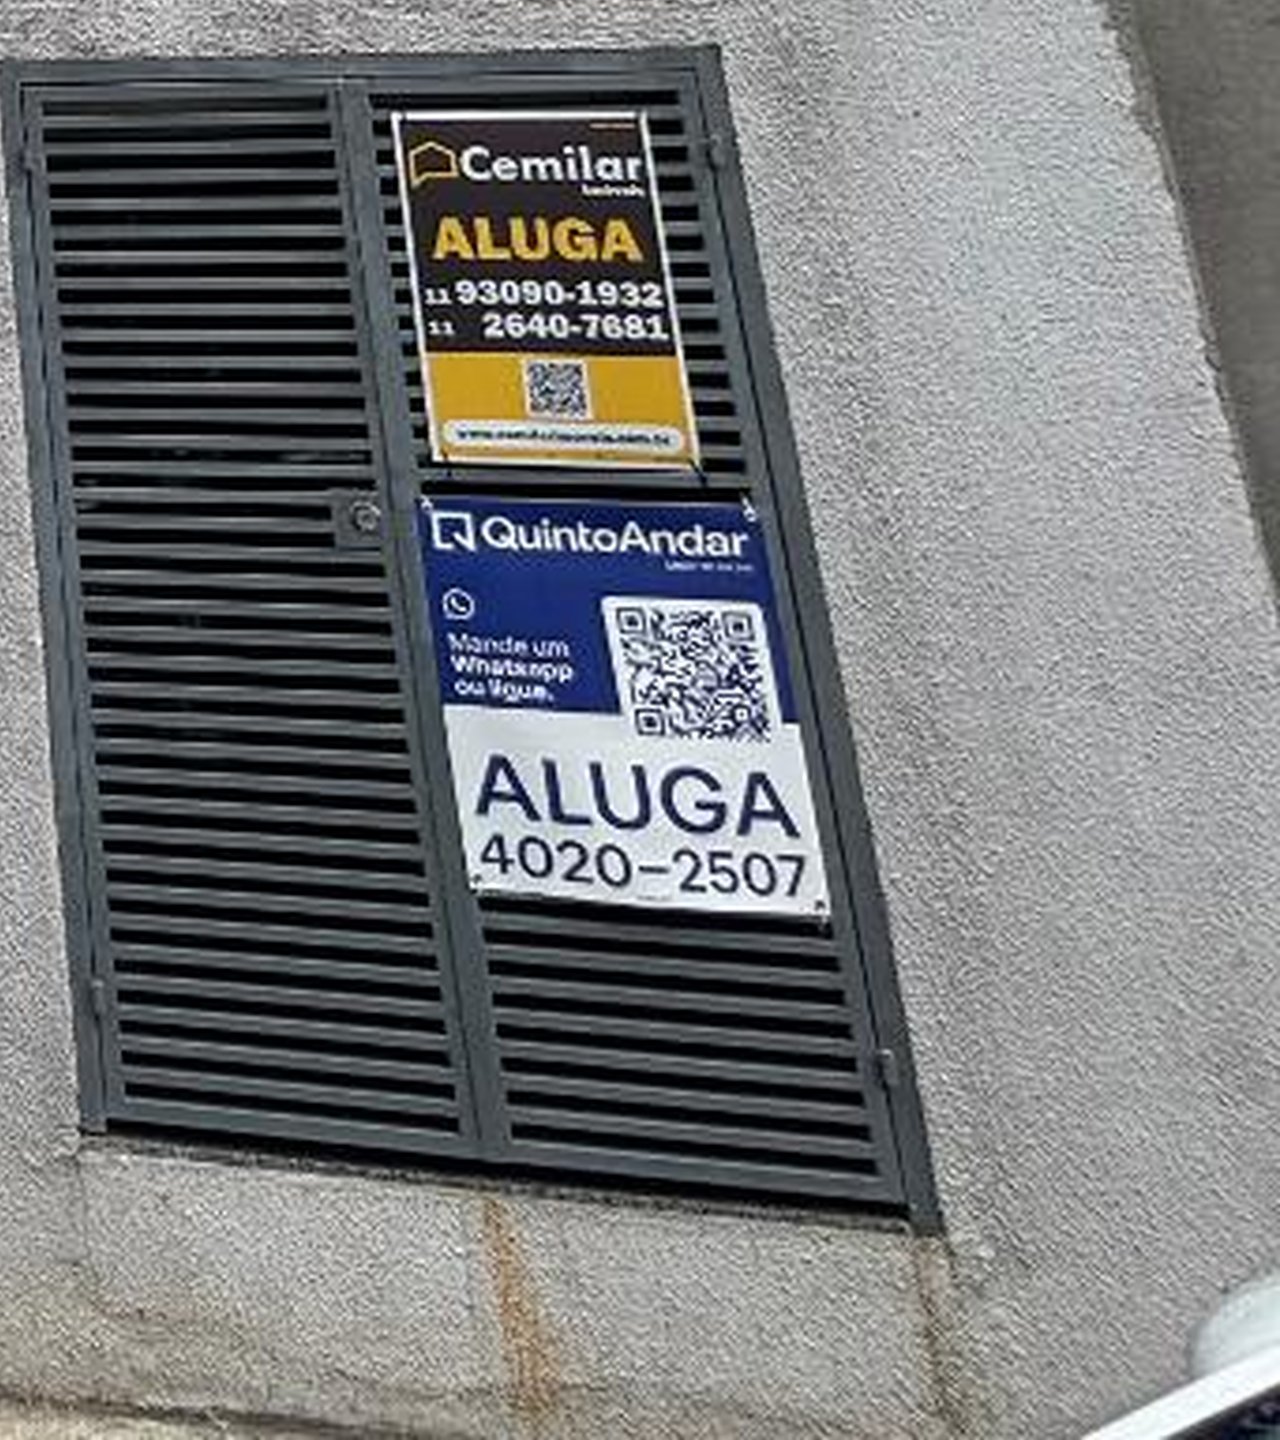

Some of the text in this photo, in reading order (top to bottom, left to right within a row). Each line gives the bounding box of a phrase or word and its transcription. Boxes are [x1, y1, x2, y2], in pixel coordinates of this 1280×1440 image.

[459, 144, 642, 181] Cemilar
[432, 216, 644, 260] ALUGA
[424, 279, 664, 308] 11 93090-1932
[482, 312, 670, 341] 2640-7681
[480, 515, 749, 557] QuintoAndar
[533, 639, 569, 657] um
[474, 753, 802, 839] ALUGA
[480, 833, 807, 897] 4020-2507
